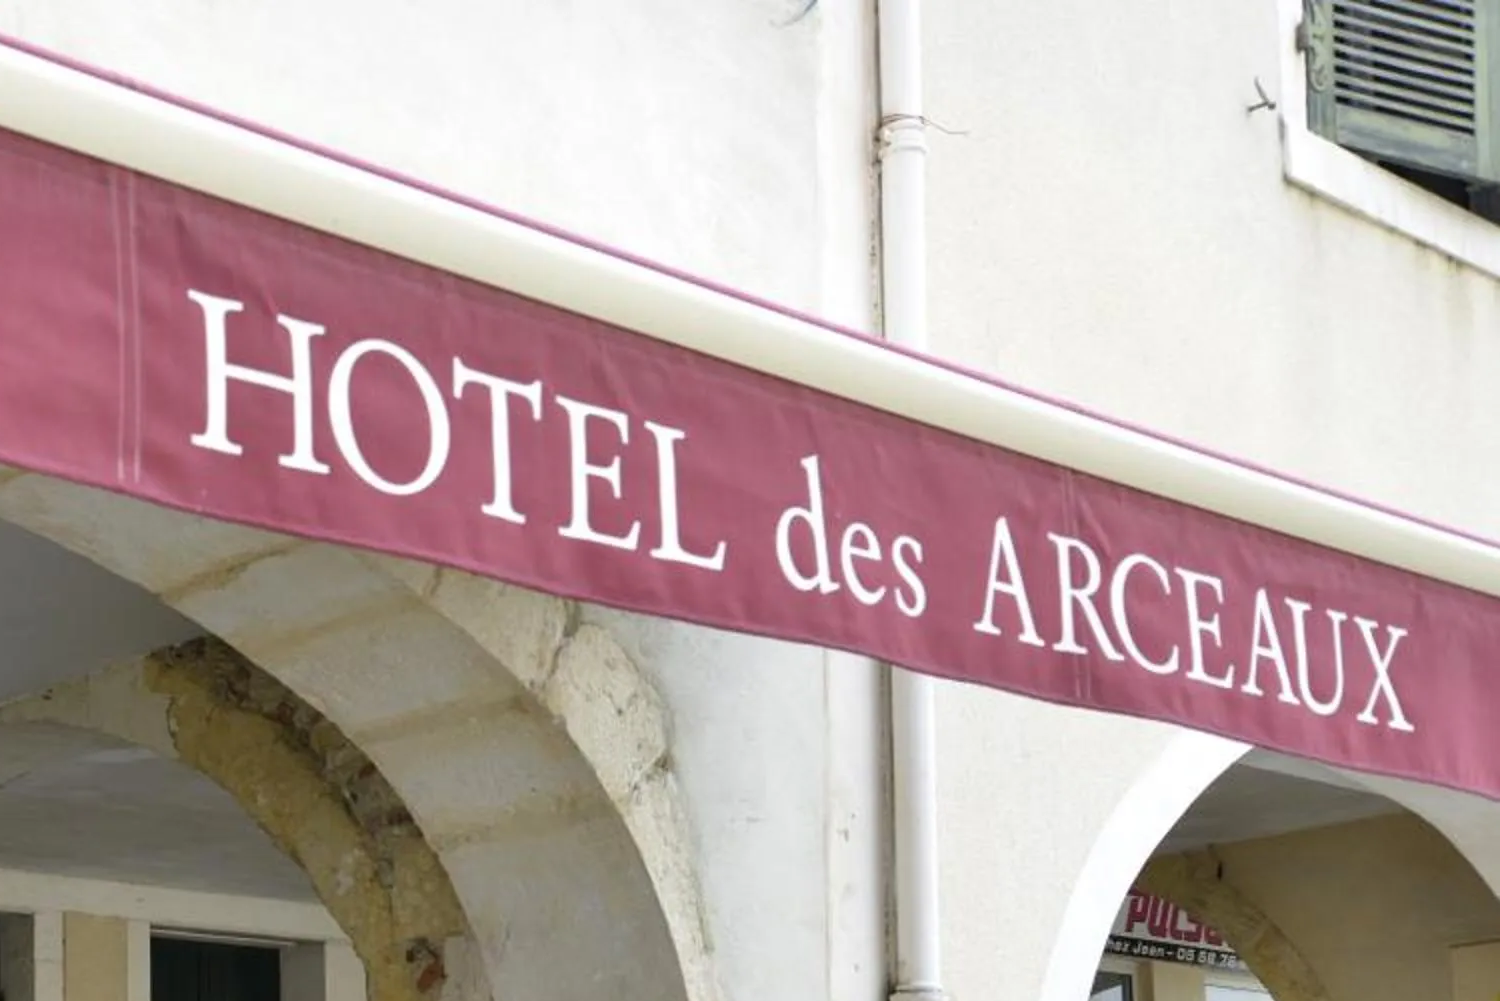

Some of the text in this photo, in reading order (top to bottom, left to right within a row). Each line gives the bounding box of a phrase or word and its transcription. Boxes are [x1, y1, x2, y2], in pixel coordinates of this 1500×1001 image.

[187, 288, 1415, 732] HOTEL des ARCEAUX
